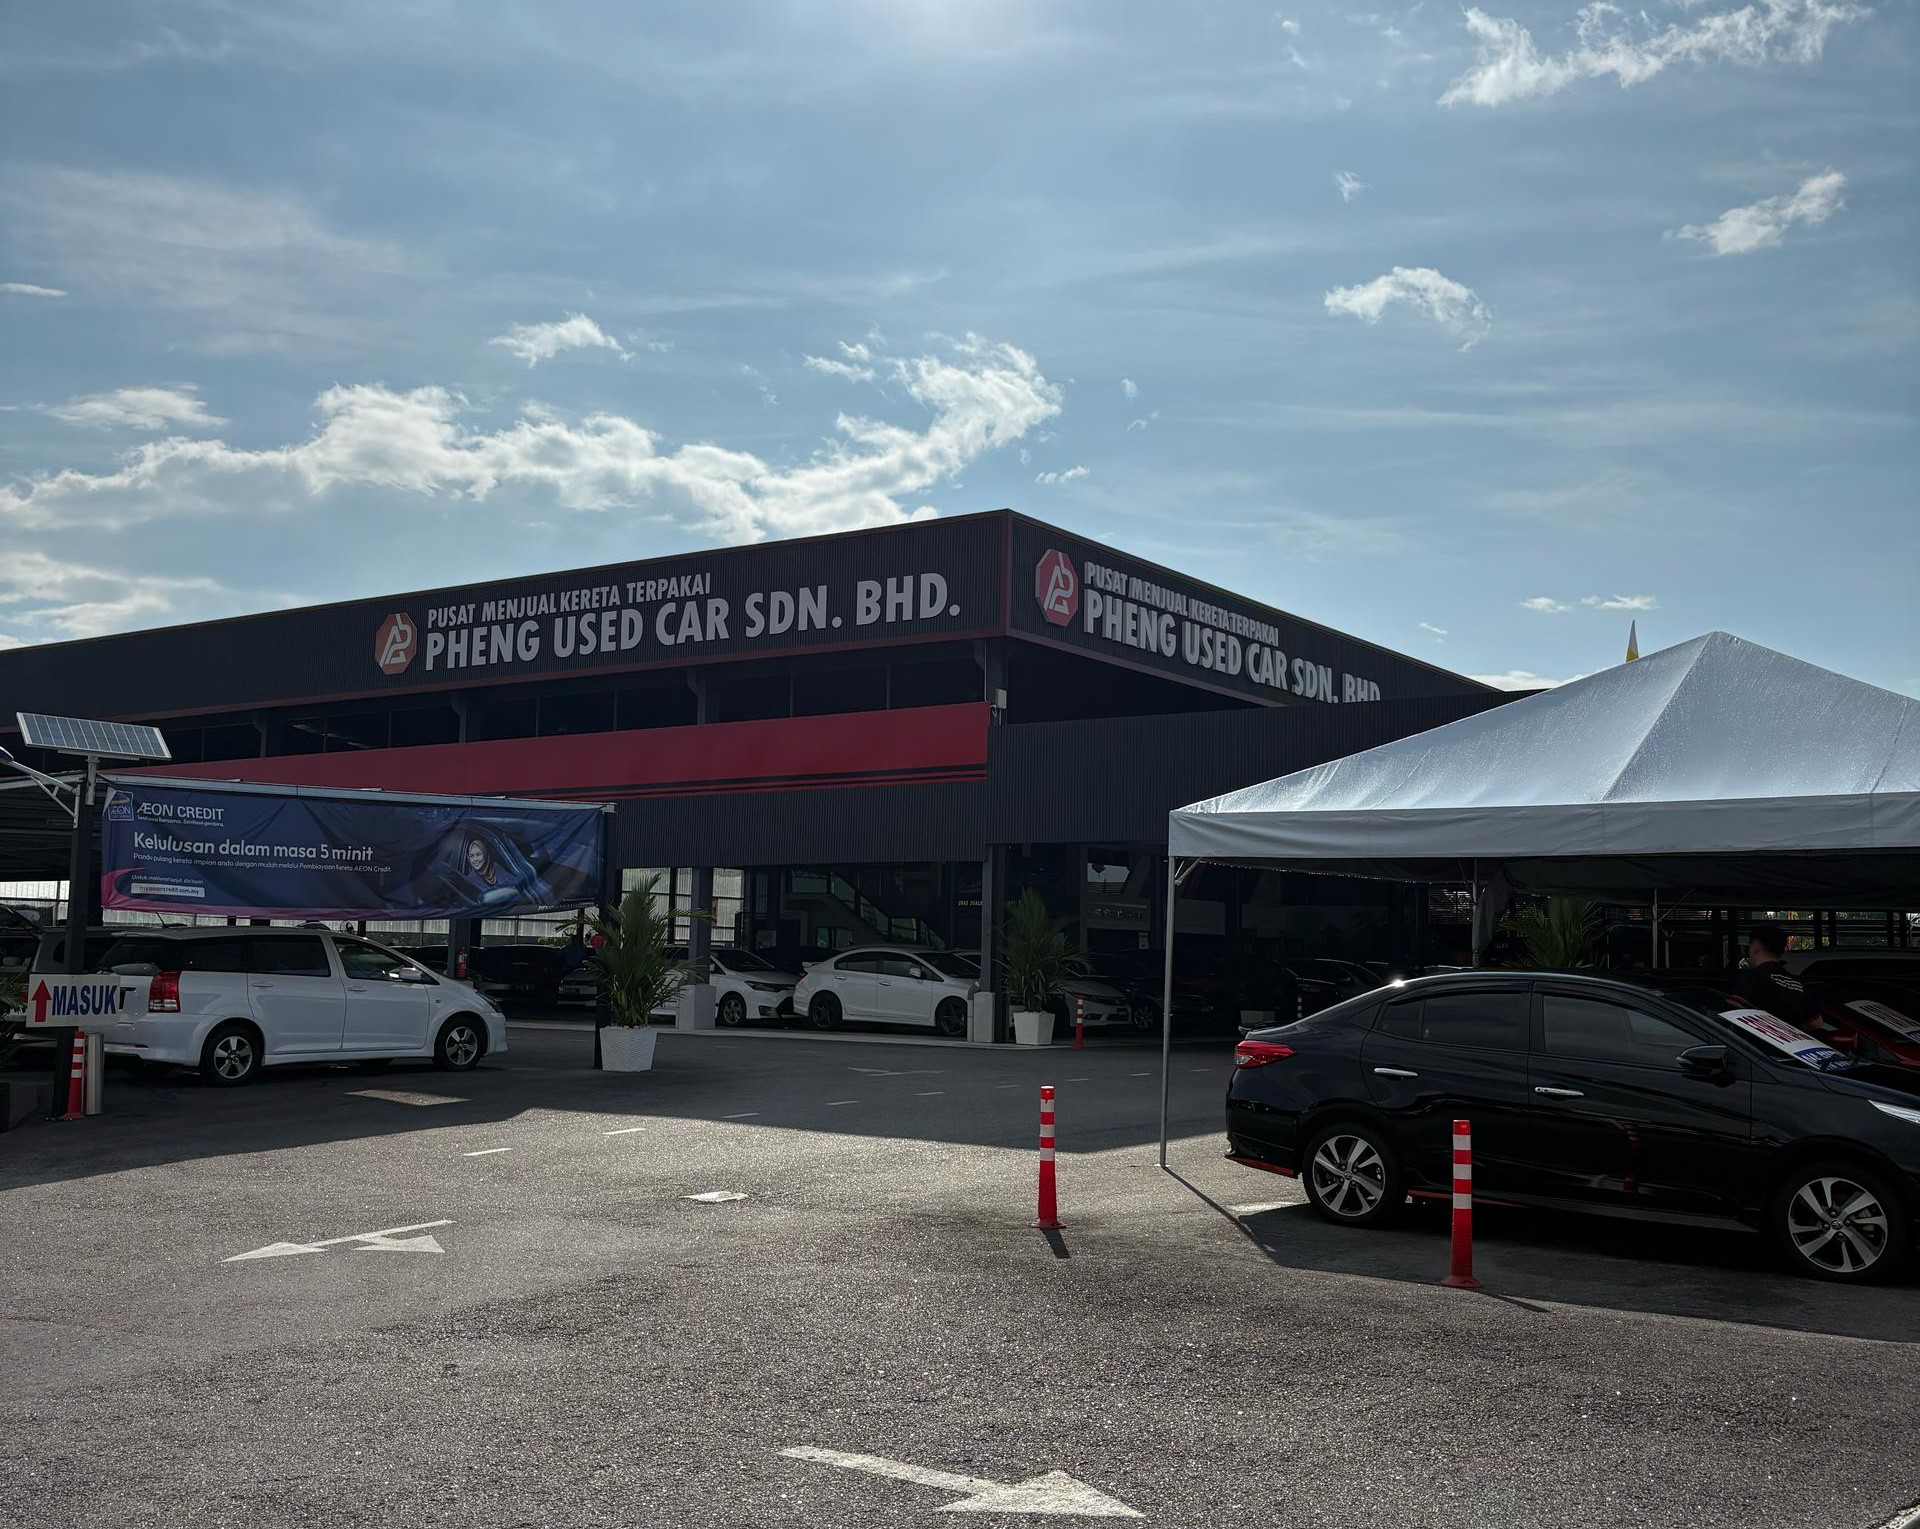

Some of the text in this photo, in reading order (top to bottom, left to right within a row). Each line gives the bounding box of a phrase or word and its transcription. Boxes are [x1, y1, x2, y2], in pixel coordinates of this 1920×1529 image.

[426, 573, 961, 671] PHENG USED CAR SDN. BHD.
[427, 573, 711, 628] PUSAT MENJUAL KERETA TERPAKAI
[1084, 562, 1279, 647] PUSAT MENJUAL KERETA TERPAKAI
[1084, 589, 1177, 658] PHENG
[1182, 621, 1241, 677] USED
[1246, 642, 1288, 691] CAR
[1292, 658, 1339, 704] SDN.
[177, 806, 224, 820] CREDIT
[134, 831, 373, 861] Kelulusan dalam masa 5 minit
[173, 856, 193, 865] kereta
[217, 859, 234, 867] anda
[235, 860, 257, 868] dengan
[52, 985, 117, 1016] MASUK
